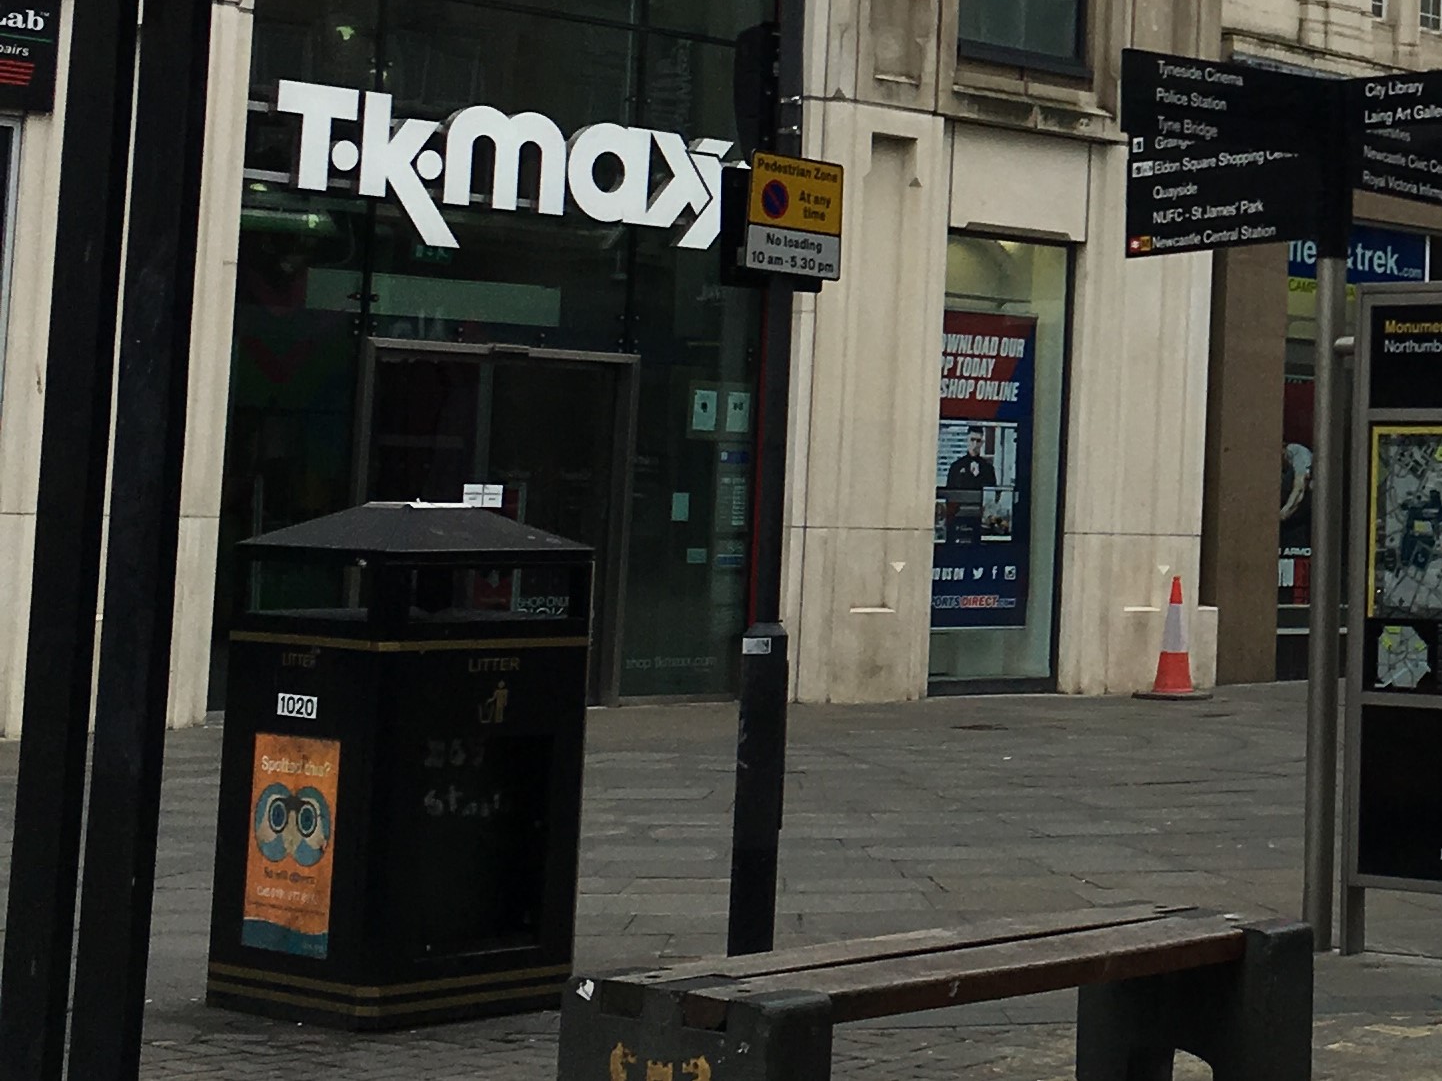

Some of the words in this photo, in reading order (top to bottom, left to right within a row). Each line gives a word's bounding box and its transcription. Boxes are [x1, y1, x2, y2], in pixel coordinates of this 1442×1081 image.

[1157, 60, 1203, 80] Tyneside
[1205, 67, 1244, 87] Cinema
[1156, 87, 1188, 106] Police
[1191, 92, 1228, 111] Station
[1365, 82, 1386, 100] City
[1388, 80, 1424, 97] Library
[1364, 108, 1393, 125] Laing
[1394, 106, 1412, 121] Art
[1157, 115, 1182, 134] Tyne
[1184, 119, 1218, 141] Bridge
[1154, 160, 1180, 174] Eldon
[1183, 155, 1217, 173] Square
[1218, 149, 1265, 167] Shopping
[1363, 144, 1406, 167] Newcastle
[1407, 154, 1428, 171] Civic
[757, 158, 812, 178] Pedestrian
[814, 168, 838, 183] Zone
[1153, 182, 1198, 201] Quayside
[1362, 170, 1386, 190] Royal
[1388, 175, 1418, 194] Victoria
[799, 190, 812, 202] At
[813, 195, 831, 209] any
[803, 207, 826, 221] time
[1152, 207, 1184, 224] NUFC
[1191, 205, 1202, 220] St
[1240, 199, 1264, 215] Park
[766, 232, 782, 246] No
[783, 235, 823, 254] loading
[1152, 232, 1202, 249] Newcastle
[1203, 227, 1239, 244] Central
[1241, 224, 1277, 241] Station
[752, 250, 765, 264] 10
[818, 262, 834, 273] pm
[1000, 337, 1025, 358] OUR
[956, 357, 996, 378] TODAY
[940, 378, 975, 399] SHOP
[976, 380, 1020, 401] ONLINE
[1283, 547, 1312, 557] ARMO
[468, 657, 520, 672] LITTER
[280, 696, 315, 716] 1020
